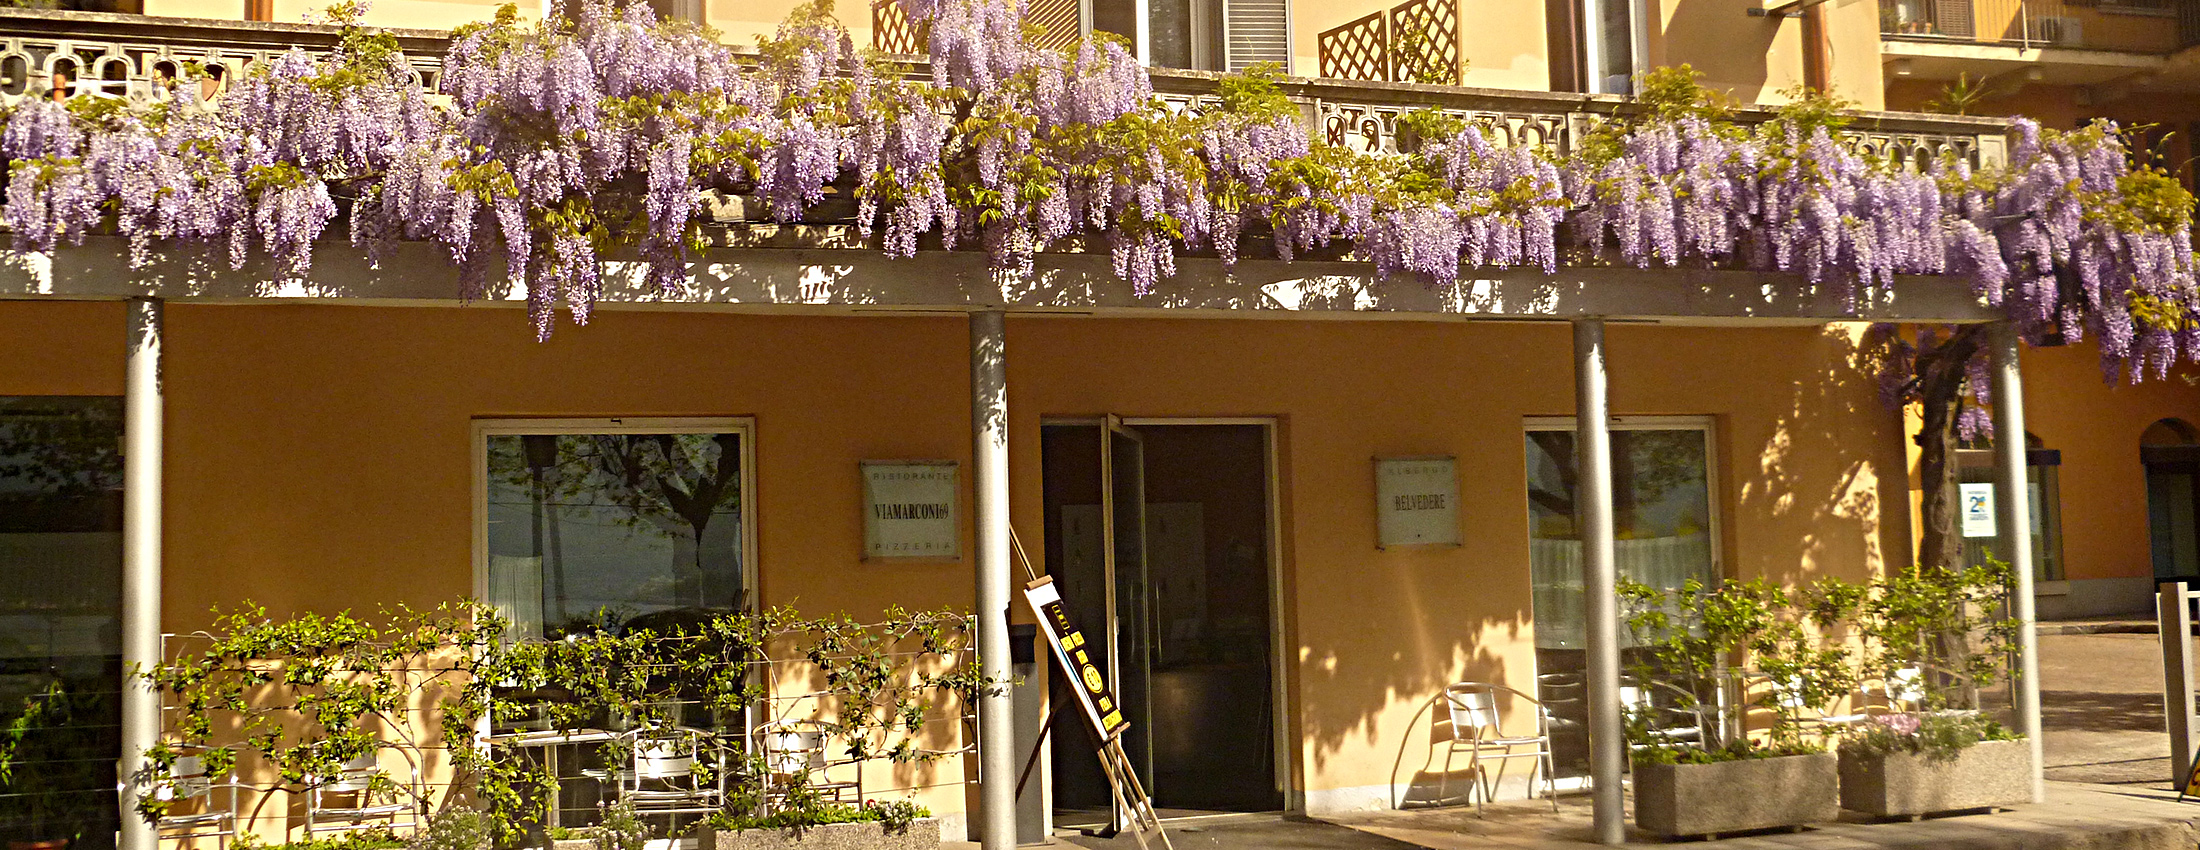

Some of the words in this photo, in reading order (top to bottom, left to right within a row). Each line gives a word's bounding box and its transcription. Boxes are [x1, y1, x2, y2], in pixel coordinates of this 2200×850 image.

[873, 472, 949, 481] RISTORANTE
[1395, 494, 1446, 511] BELVEDERE
[875, 503, 949, 520] VIAMARCONI69
